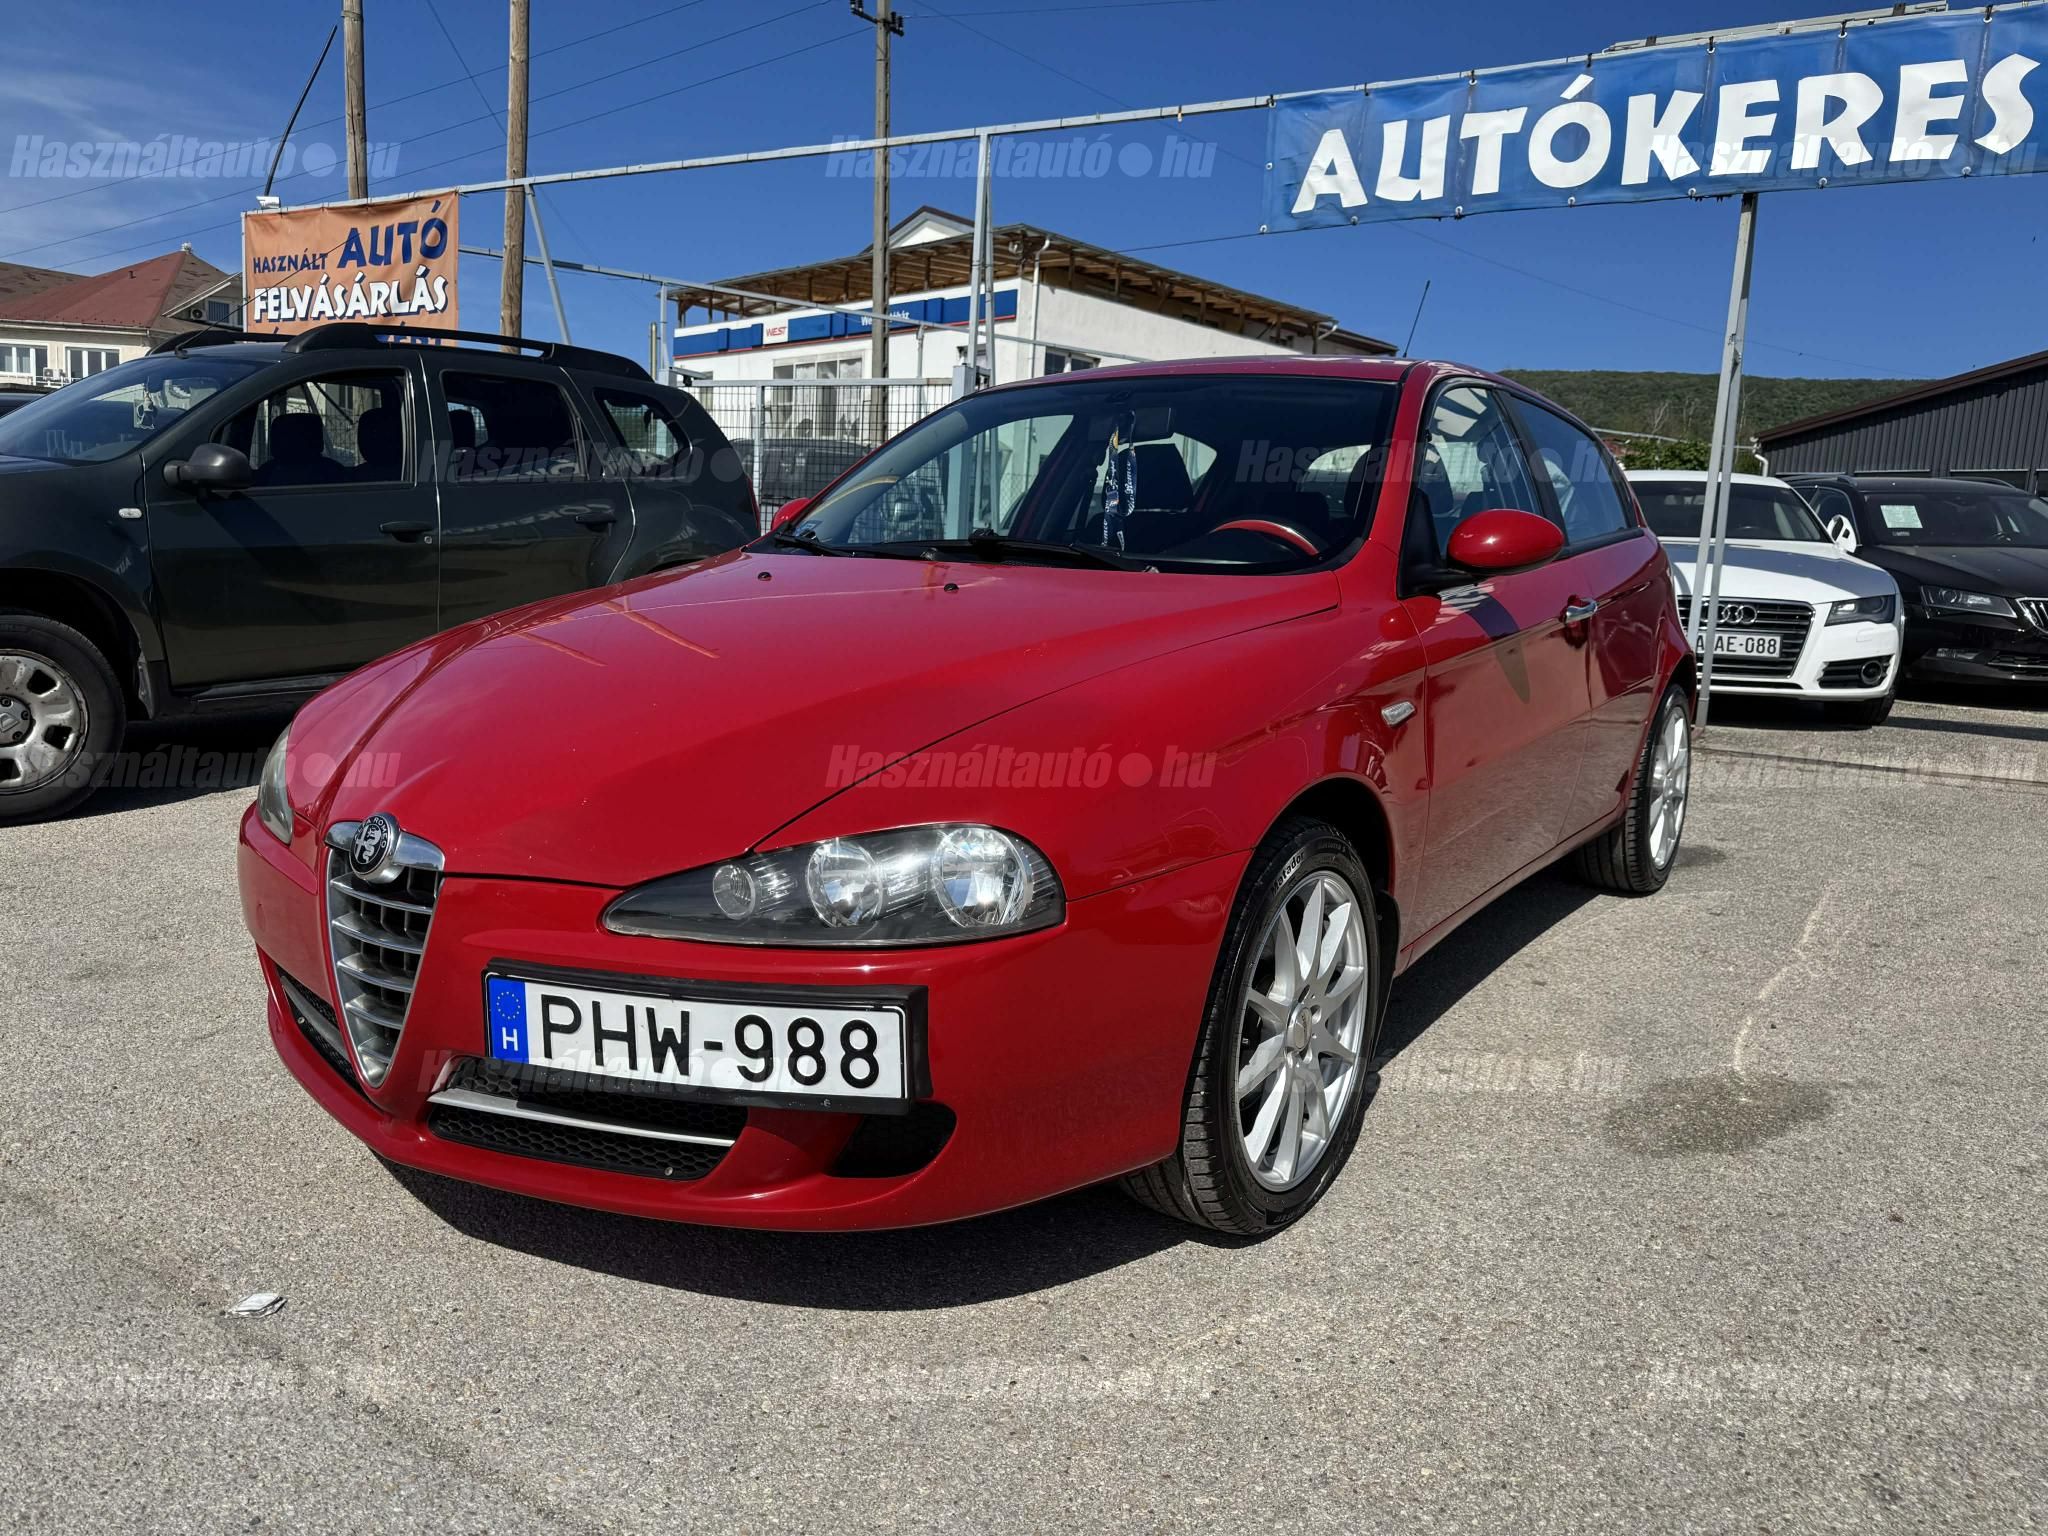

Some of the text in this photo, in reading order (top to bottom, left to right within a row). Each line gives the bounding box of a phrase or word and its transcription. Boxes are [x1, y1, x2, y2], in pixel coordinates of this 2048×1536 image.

[1291, 53, 2040, 214] AUTÓKERES
[253, 200, 448, 273] HASZNÁLT AUTÓ
[254, 265, 449, 322] FELVÁSÁRLÁS
[766, 326, 787, 337] WEST
[1714, 636, 1777, 654] AE-088
[373, 816, 388, 849] ROMEO
[1271, 851, 1305, 897] Matador
[501, 1027, 518, 1052] H
[541, 993, 881, 1090] PHW-988
